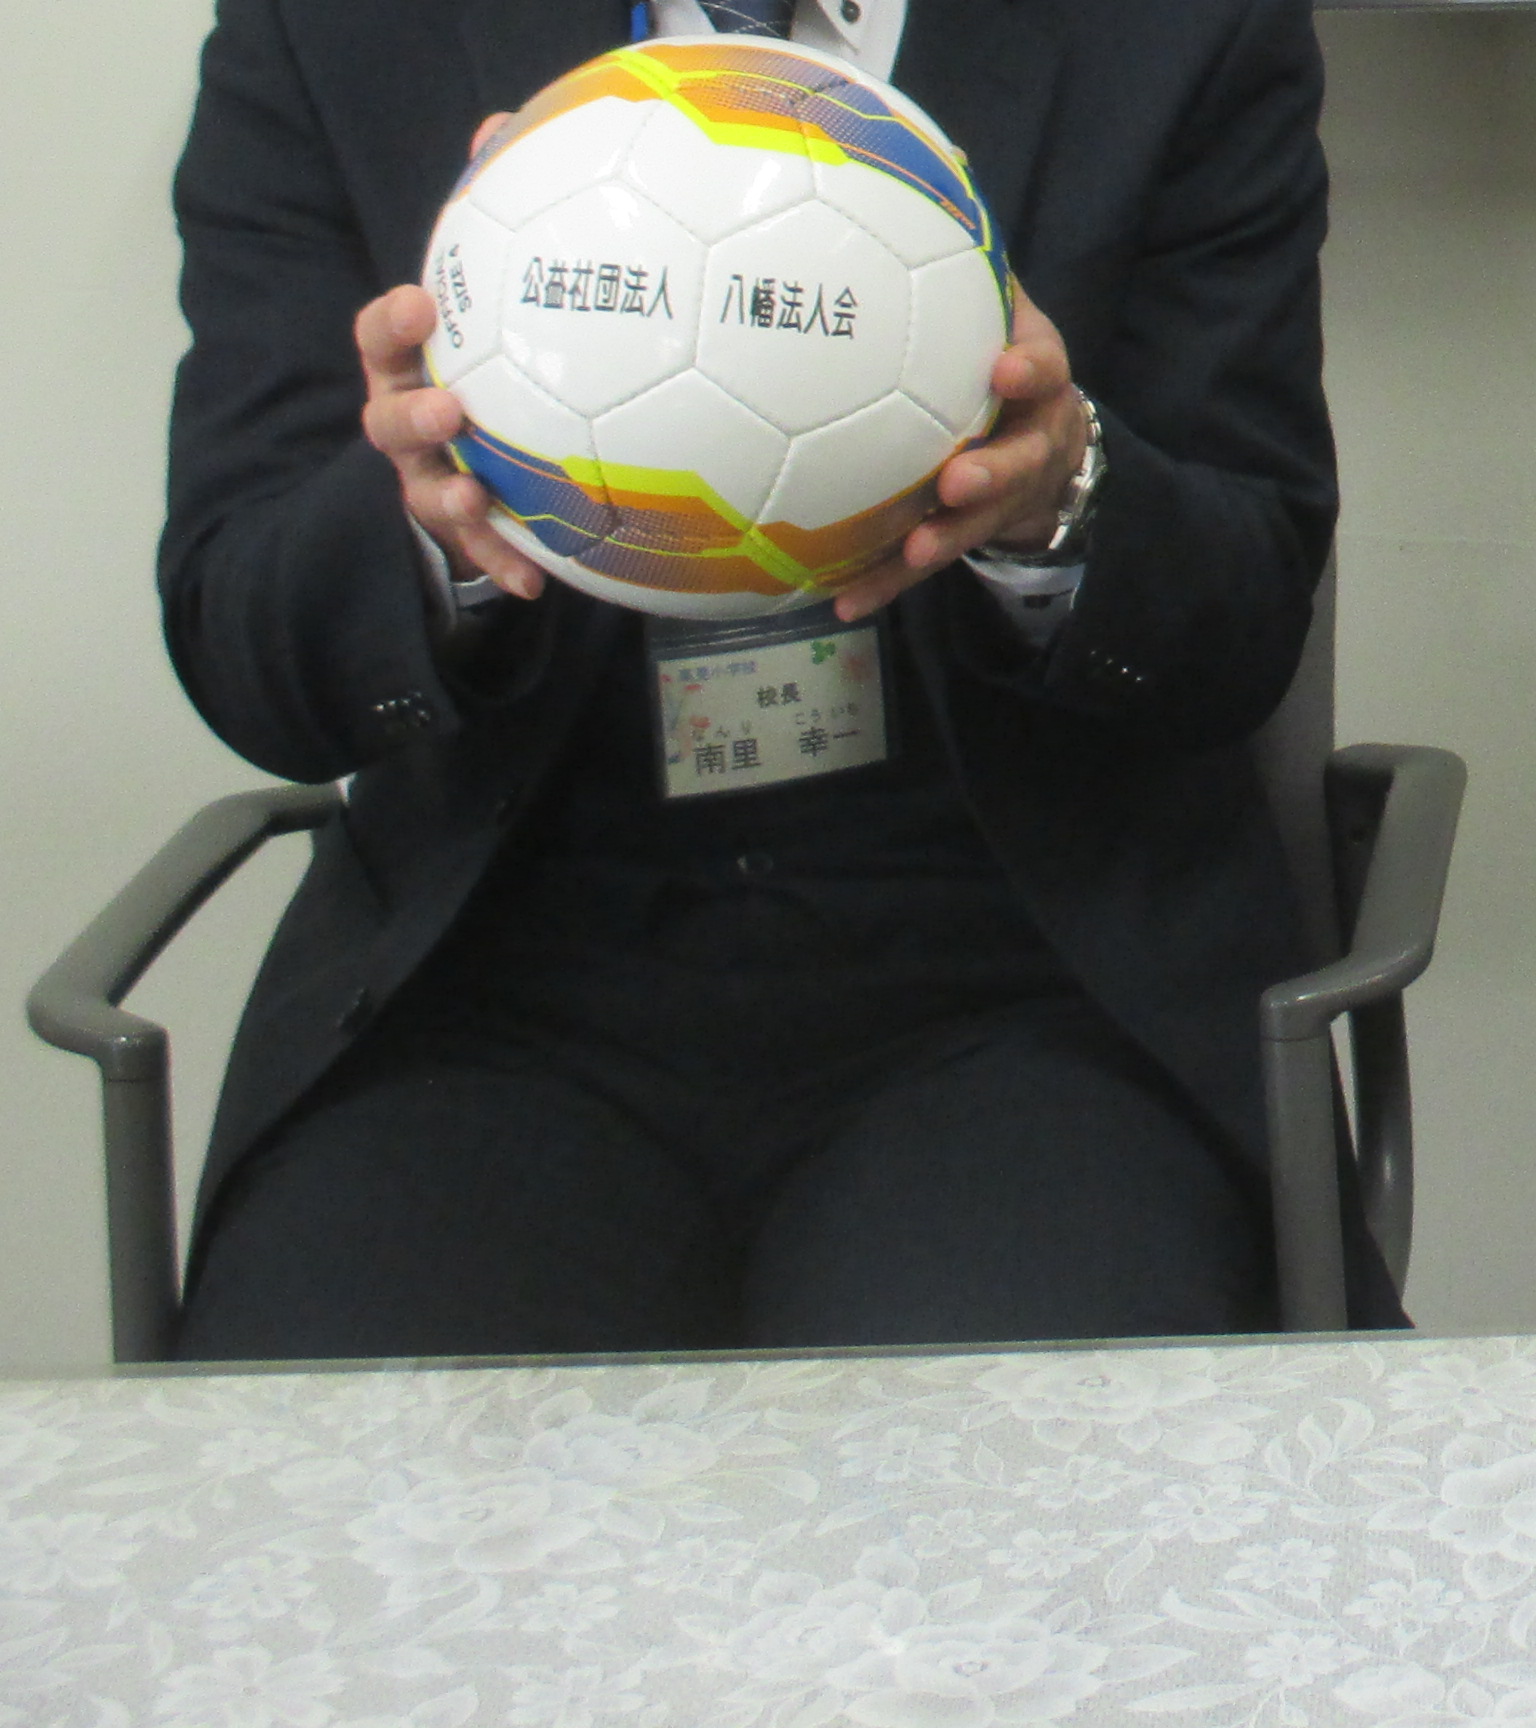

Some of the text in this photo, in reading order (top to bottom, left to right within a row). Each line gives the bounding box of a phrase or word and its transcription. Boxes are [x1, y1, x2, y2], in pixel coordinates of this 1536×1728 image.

[520, 256, 859, 340] 公益社団法人 八幡法人会
[694, 725, 860, 774] 南里 幸一
